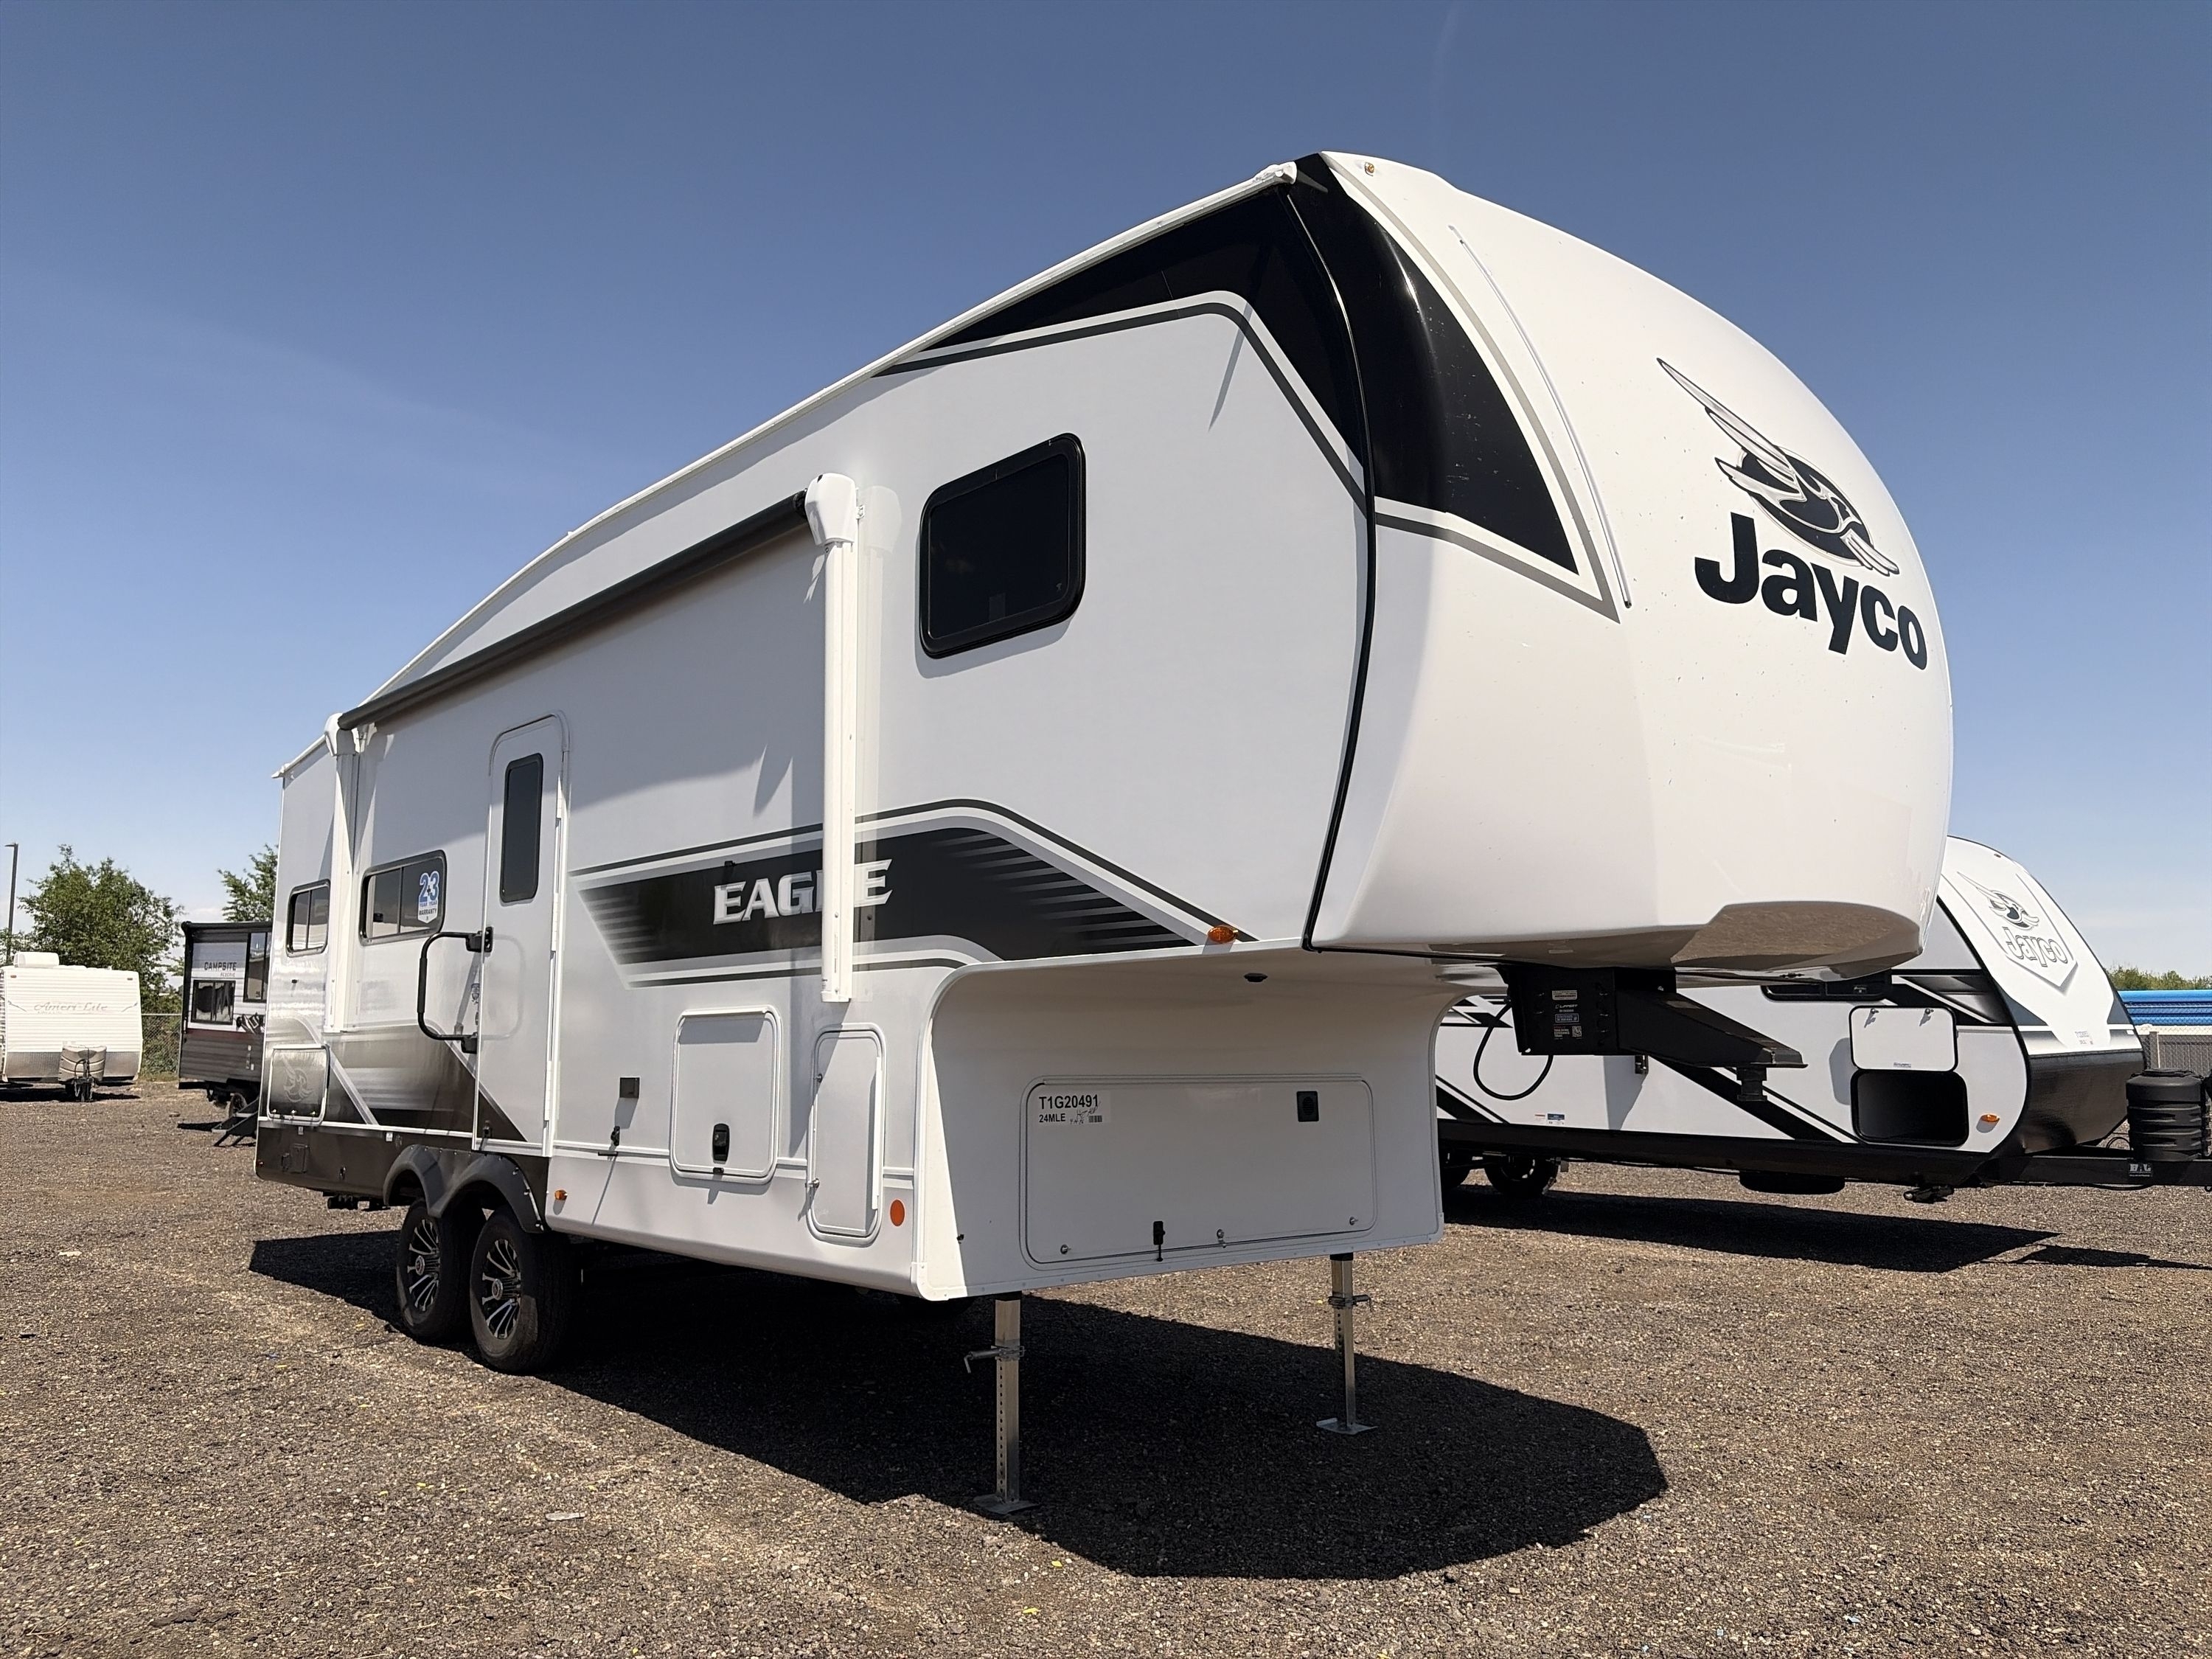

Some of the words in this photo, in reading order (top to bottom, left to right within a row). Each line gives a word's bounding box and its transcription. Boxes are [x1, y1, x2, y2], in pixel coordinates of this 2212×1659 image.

[1694, 512, 1927, 670] Jayco
[713, 859, 892, 925] EAGE
[2002, 926, 2067, 967] Jayco
[204, 961, 237, 970] CAMPSITE
[1039, 1094, 1098, 1109] T1G20491
[1039, 1113, 1065, 1122] 24MLE
